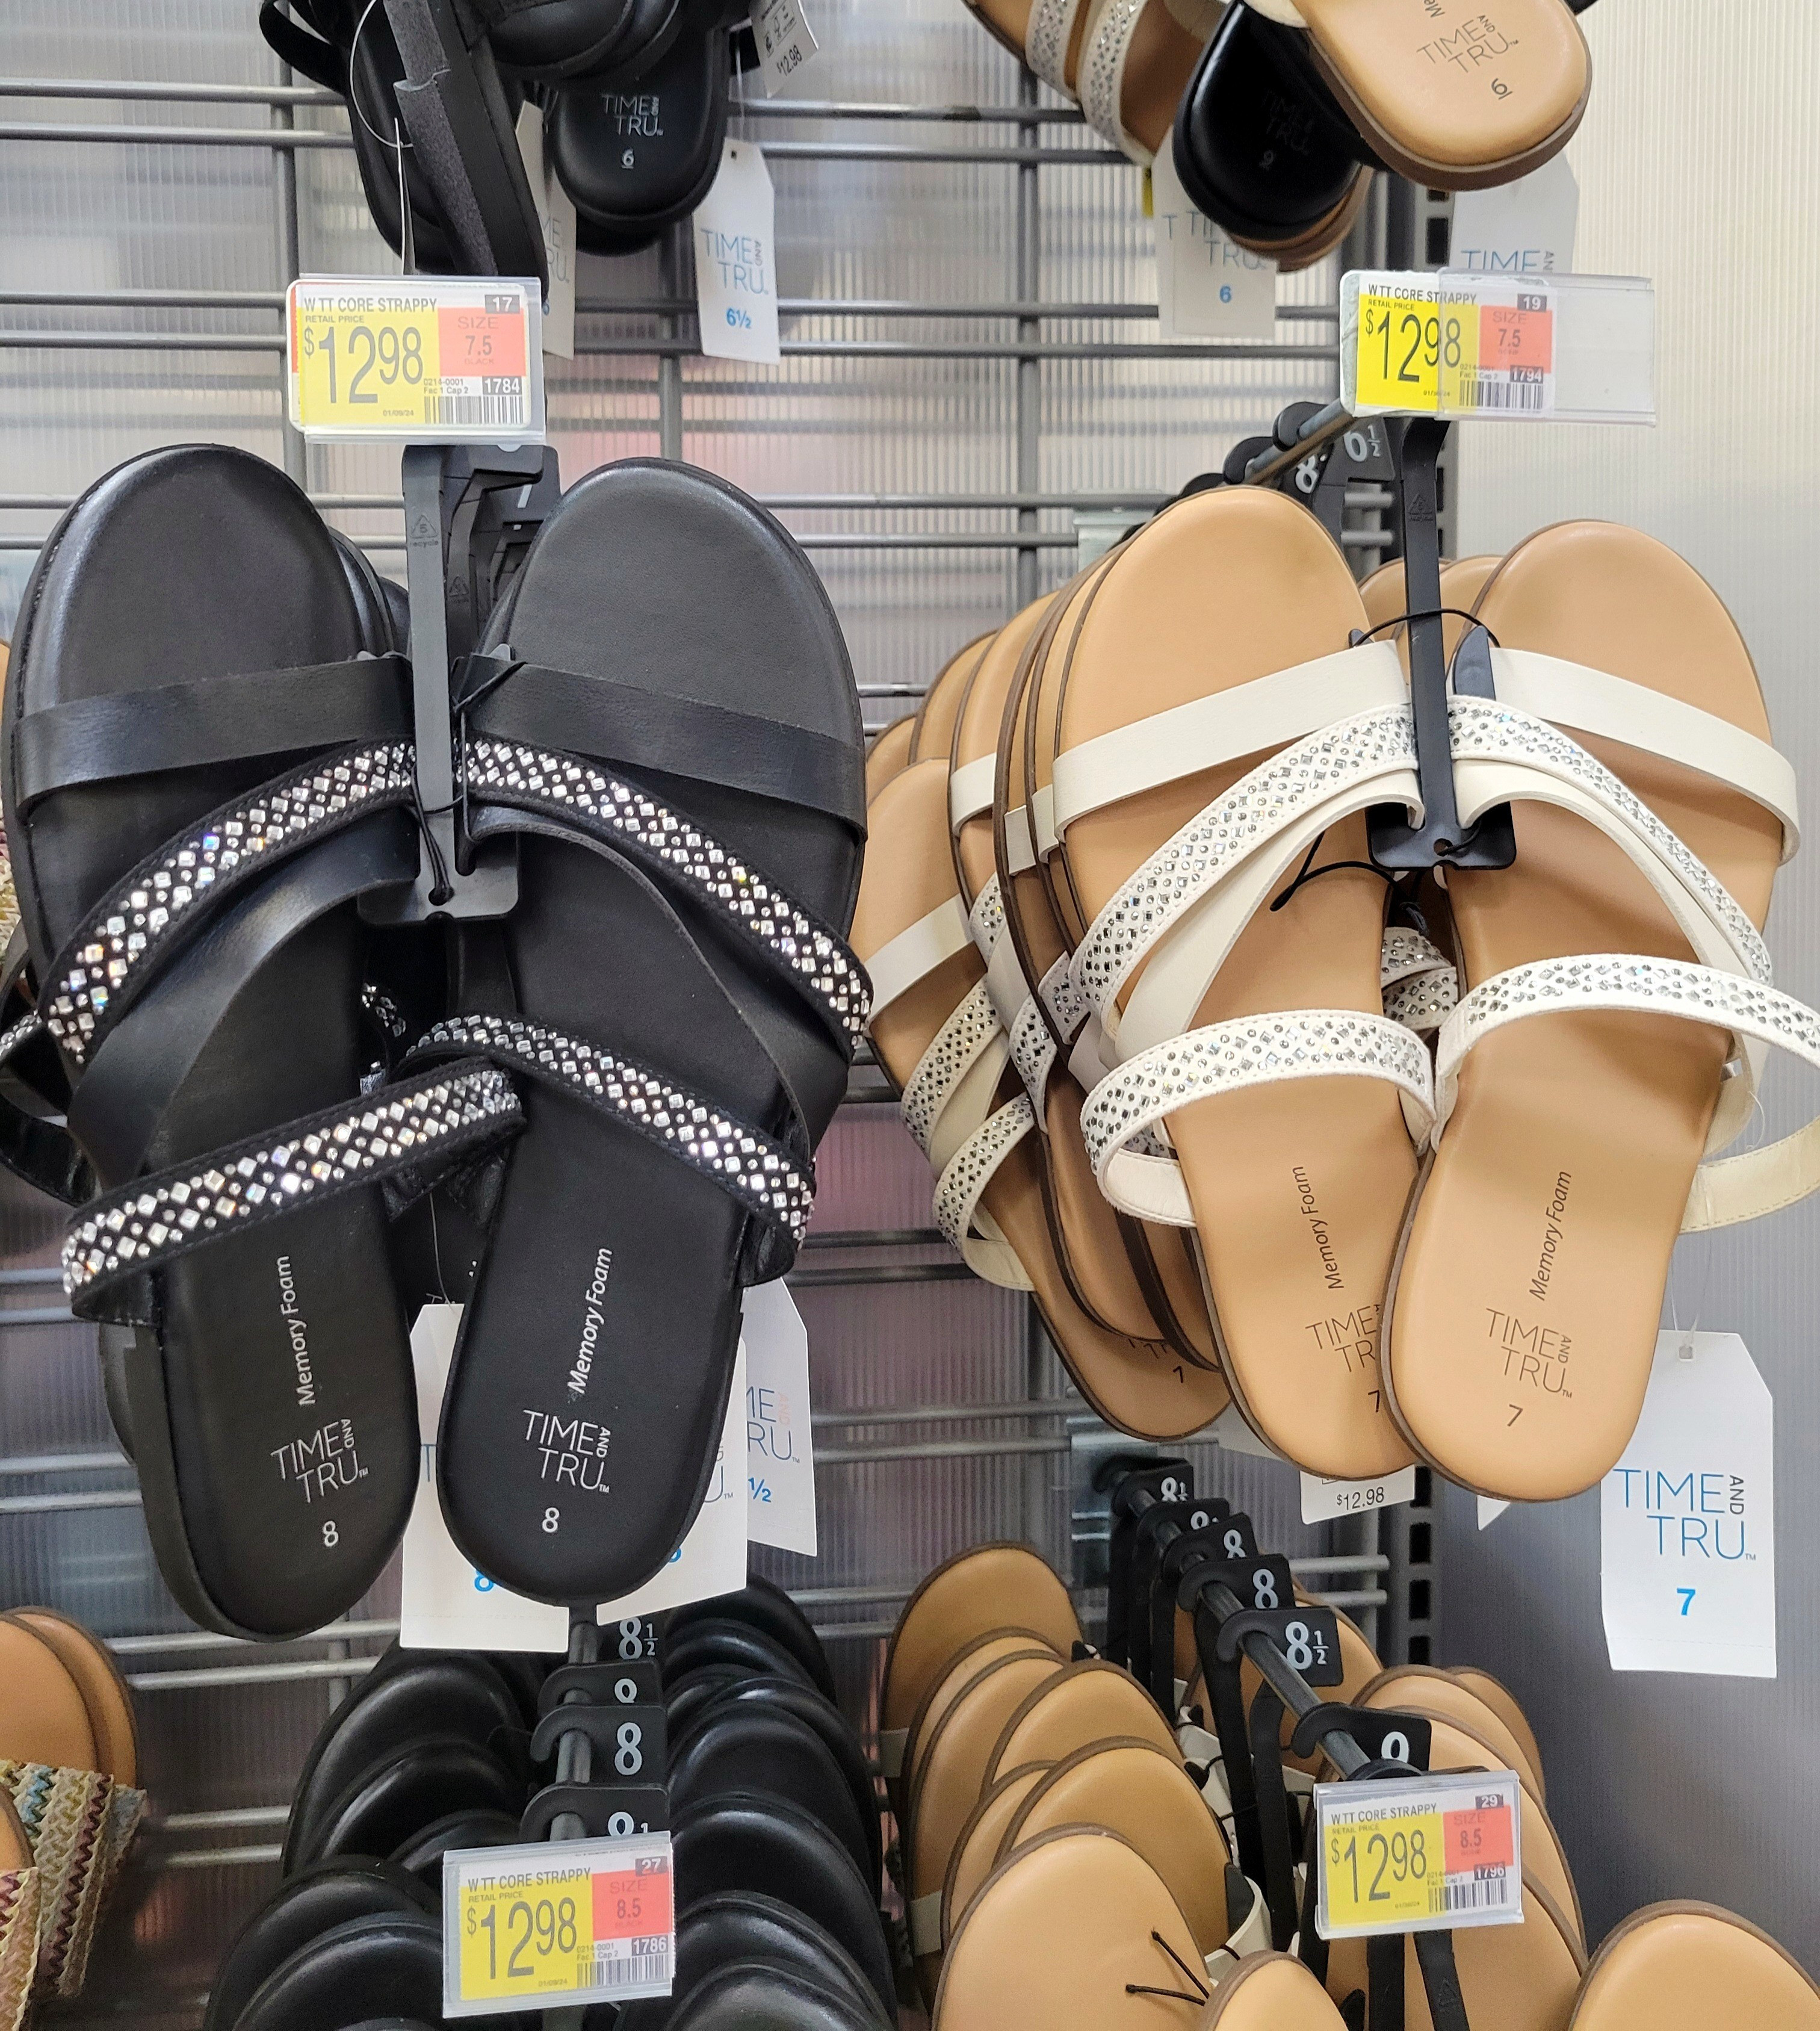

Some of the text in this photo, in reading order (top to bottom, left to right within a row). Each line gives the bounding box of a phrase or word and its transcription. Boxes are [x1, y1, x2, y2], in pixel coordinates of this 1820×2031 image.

[1416, 14, 1496, 64] TIME AND
[776, 45, 802, 76] $12.98
[1491, 78, 1509, 96] 6
[602, 95, 651, 116] TIME
[622, 149, 634, 167] 6
[700, 229, 753, 265] TIME
[338, 297, 374, 312] CORE
[378, 297, 437, 312] STRAPPY
[492, 297, 512, 312] 17
[1219, 286, 1232, 304] 6
[1368, 299, 1414, 311] RETAIL PRICE
[1394, 287, 1423, 302] CORE
[1426, 291, 1476, 305] STRAPPY
[1523, 297, 1541, 310] 19
[457, 317, 499, 329] SIZE
[1493, 311, 1527, 324] SIZE
[465, 335, 492, 356] 7.5
[1498, 329, 1521, 347] 7.5
[1513, 367, 1542, 382] 1794
[484, 379, 520, 393] 1784
[1292, 1166, 1319, 1215] Foam
[1545, 1171, 1572, 1223] Foam
[1309, 1218, 1345, 1289] Memory
[1529, 1223, 1563, 1301] Memory
[276, 1256, 299, 1316] Foam
[585, 1248, 613, 1306] Foam
[1305, 1306, 1377, 1350] TIME
[1486, 1307, 1572, 1363] TIME AND
[567, 1306, 605, 1395] Memory
[1334, 1339, 1376, 1372] TR
[287, 1319, 317, 1406] Memory
[1367, 1389, 1380, 1413] 7
[1507, 1404, 1523, 1427] 7
[523, 1409, 611, 1458] TIME AND
[747, 1421, 792, 1461] RU
[270, 1418, 355, 1480] TIME AND
[1336, 1486, 1384, 1510] $12.98
[1613, 1469, 1745, 1515] TIME AND
[542, 1507, 560, 1533] 8
[322, 1520, 339, 1547] 8
[1252, 1569, 1278, 1609] 8
[1676, 1588, 1696, 1616] 7
[614, 1722, 642, 1775] 8
[1358, 1808, 1387, 1822] CORE
[1390, 1803, 1437, 1819] STRAPPY
[1481, 1795, 1497, 1808] 29
[1332, 1823, 1379, 1835] RETAIL PRICE
[1453, 1812, 1485, 1826] SIZE
[1460, 1828, 1482, 1848] 8.5
[642, 1858, 661, 1874] 27
[1477, 1866, 1505, 1879] 1796
[499, 1873, 533, 1890] CORE
[536, 1867, 590, 1886] STRAPPY
[610, 1878, 648, 1894] SIZE
[469, 1891, 524, 1903] RETAIL PRICE
[617, 1897, 641, 1919] 8.5
[577, 1943, 614, 1953] 0214-0001
[598, 1951, 612, 1960] Cap
[634, 1938, 666, 1955] 1786
